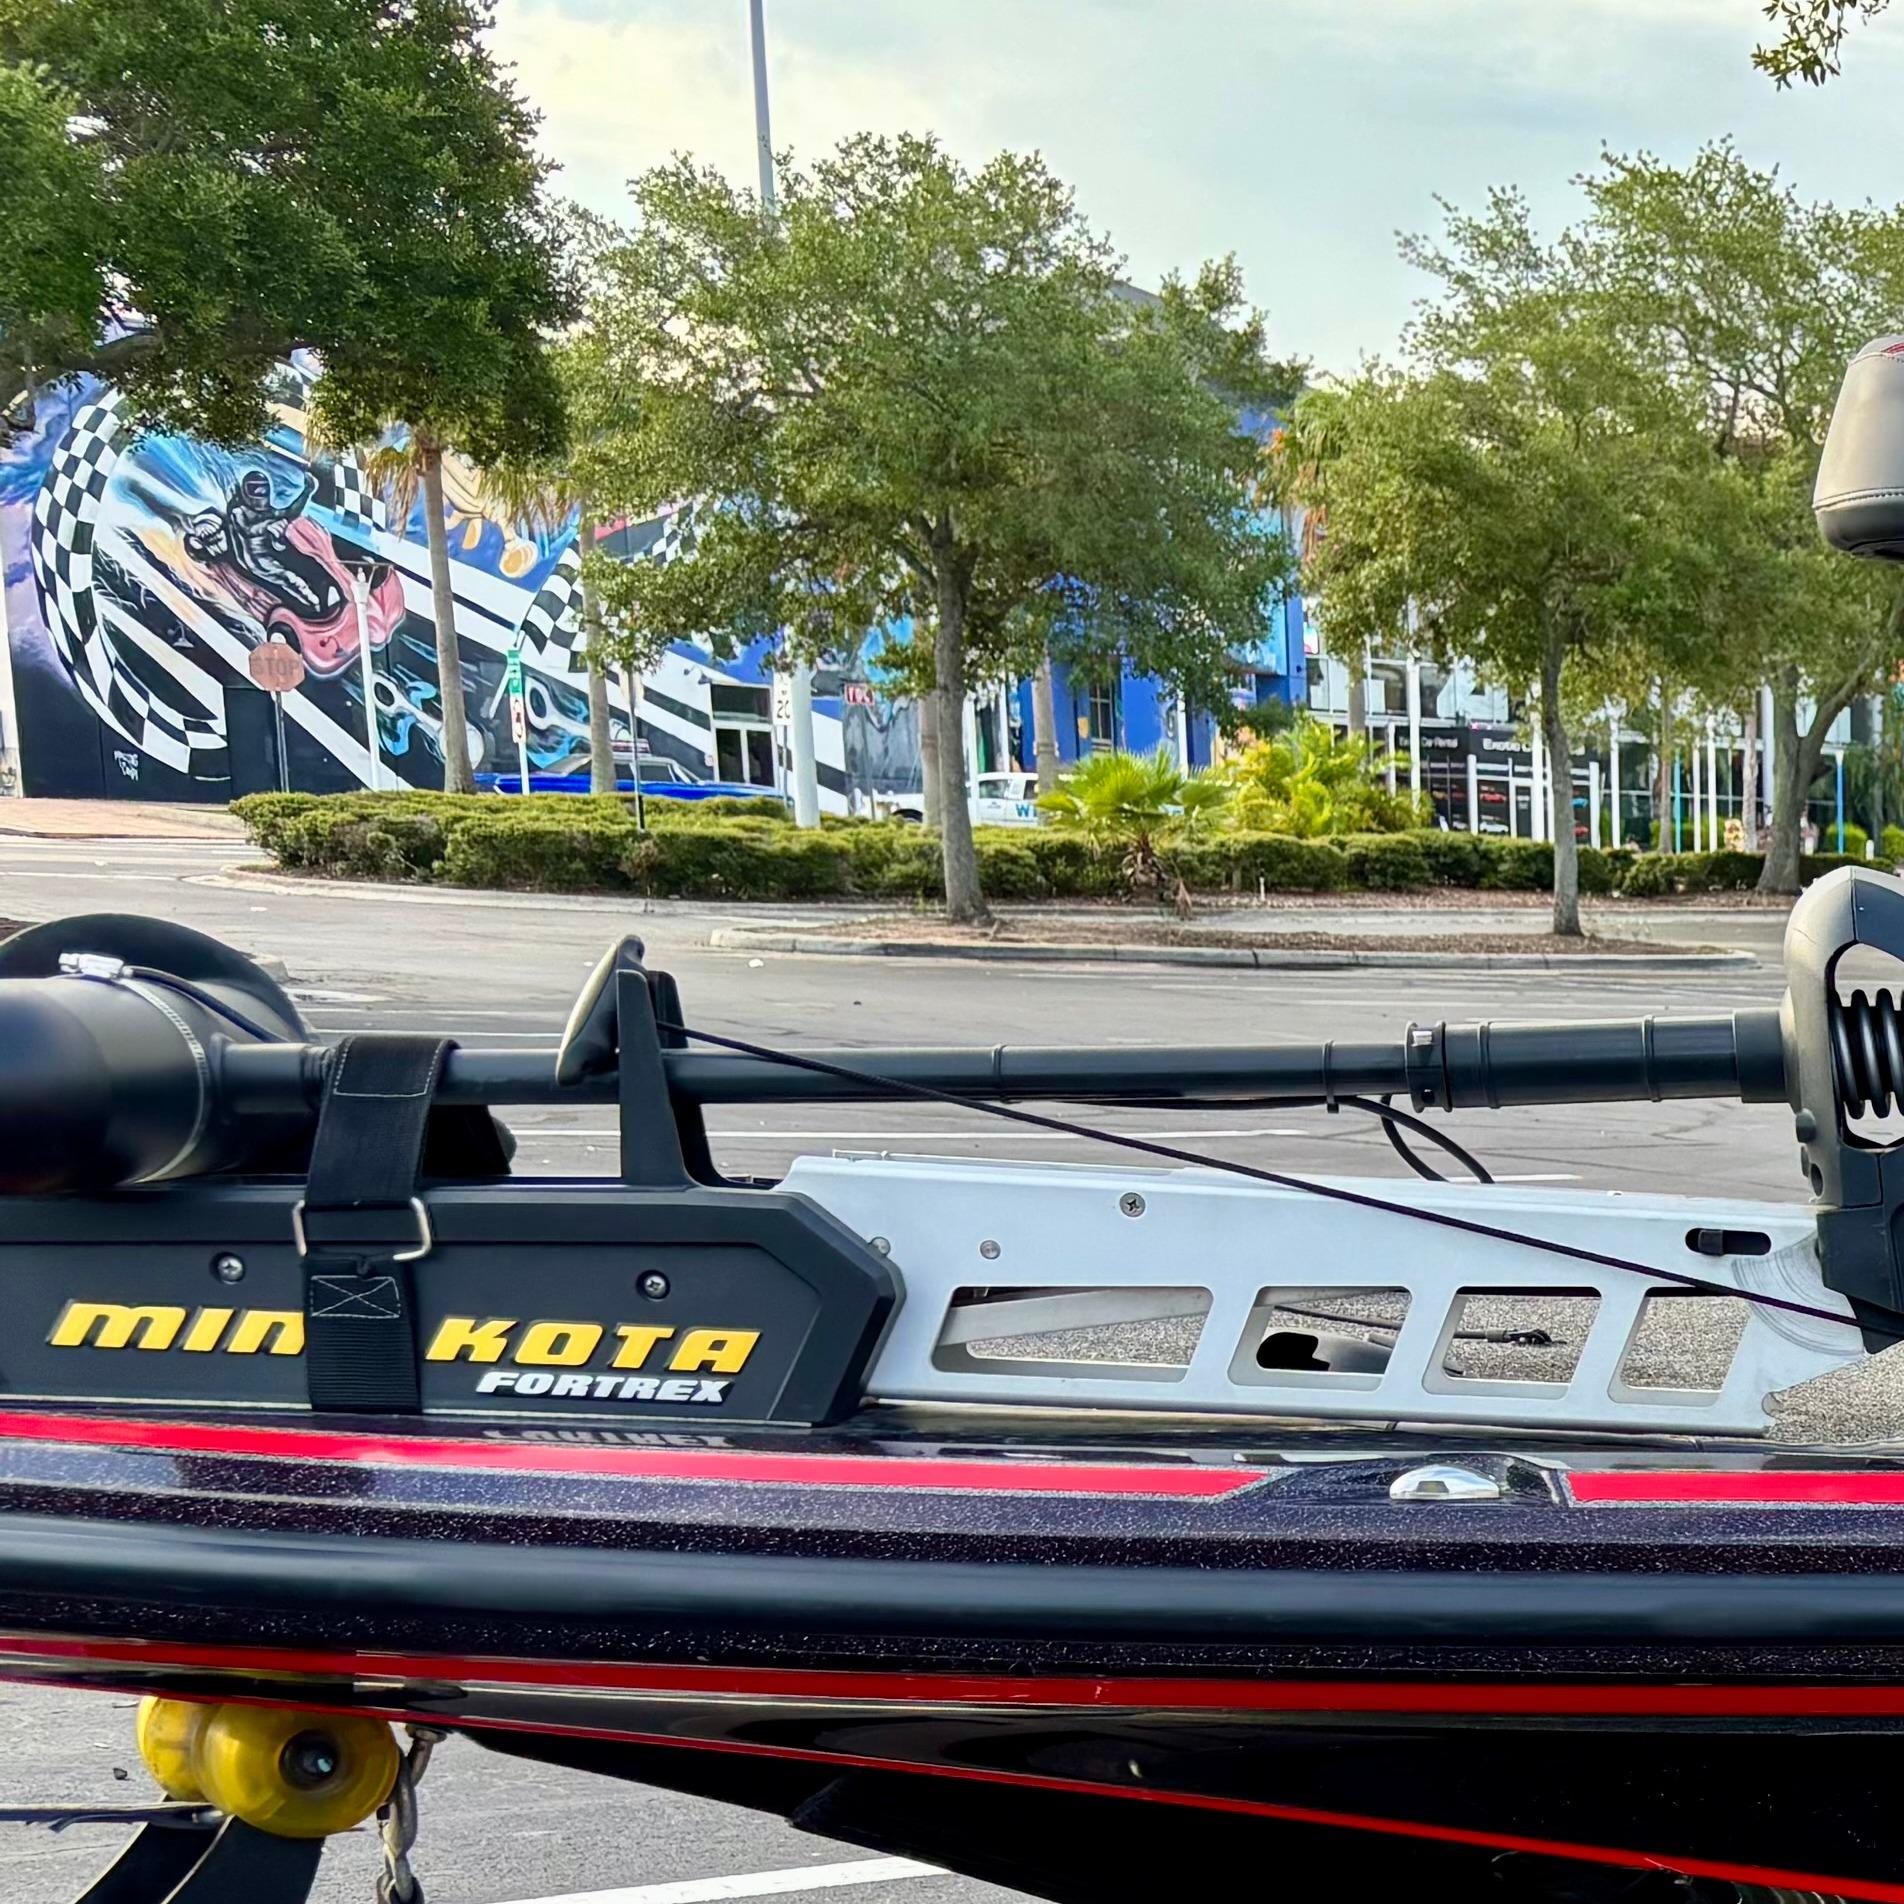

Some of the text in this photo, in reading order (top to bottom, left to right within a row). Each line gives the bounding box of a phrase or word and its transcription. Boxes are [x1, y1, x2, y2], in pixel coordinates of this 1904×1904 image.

[252, 657, 300, 676] STOP
[47, 1299, 761, 1374] MIN KOTA
[475, 1372, 734, 1402] FORTREX
